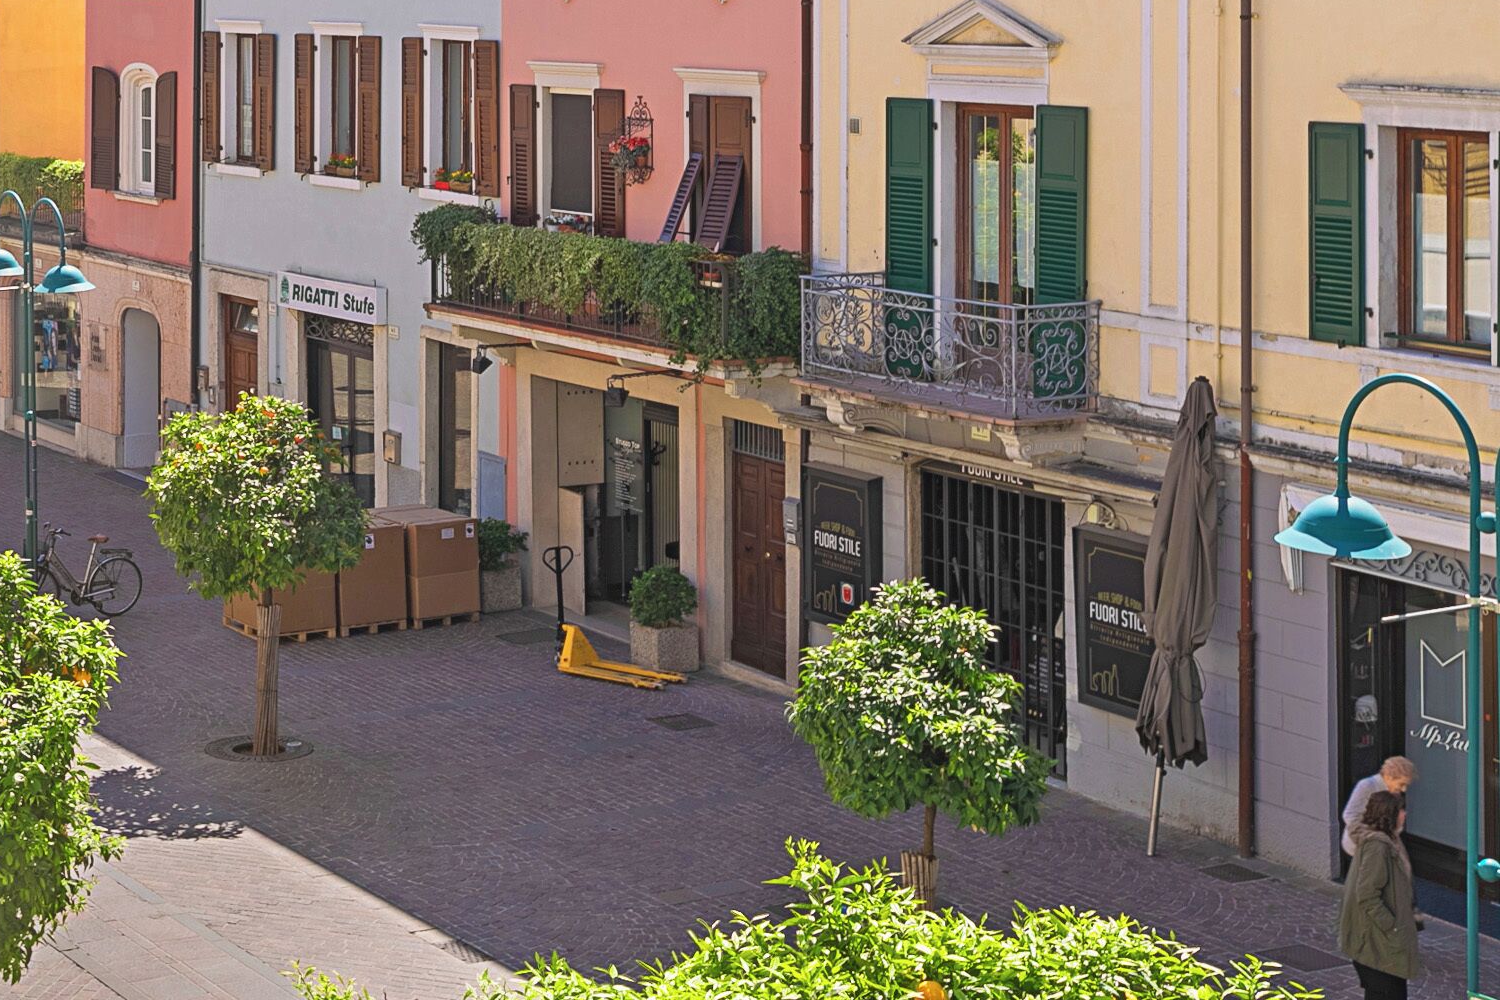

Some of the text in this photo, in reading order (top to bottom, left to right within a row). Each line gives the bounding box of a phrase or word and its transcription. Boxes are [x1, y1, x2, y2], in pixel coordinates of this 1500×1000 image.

[292, 283, 375, 315] RIGATTI Stufe
[814, 530, 861, 557] FUORI STILE
[1090, 601, 1119, 625] FUORI
